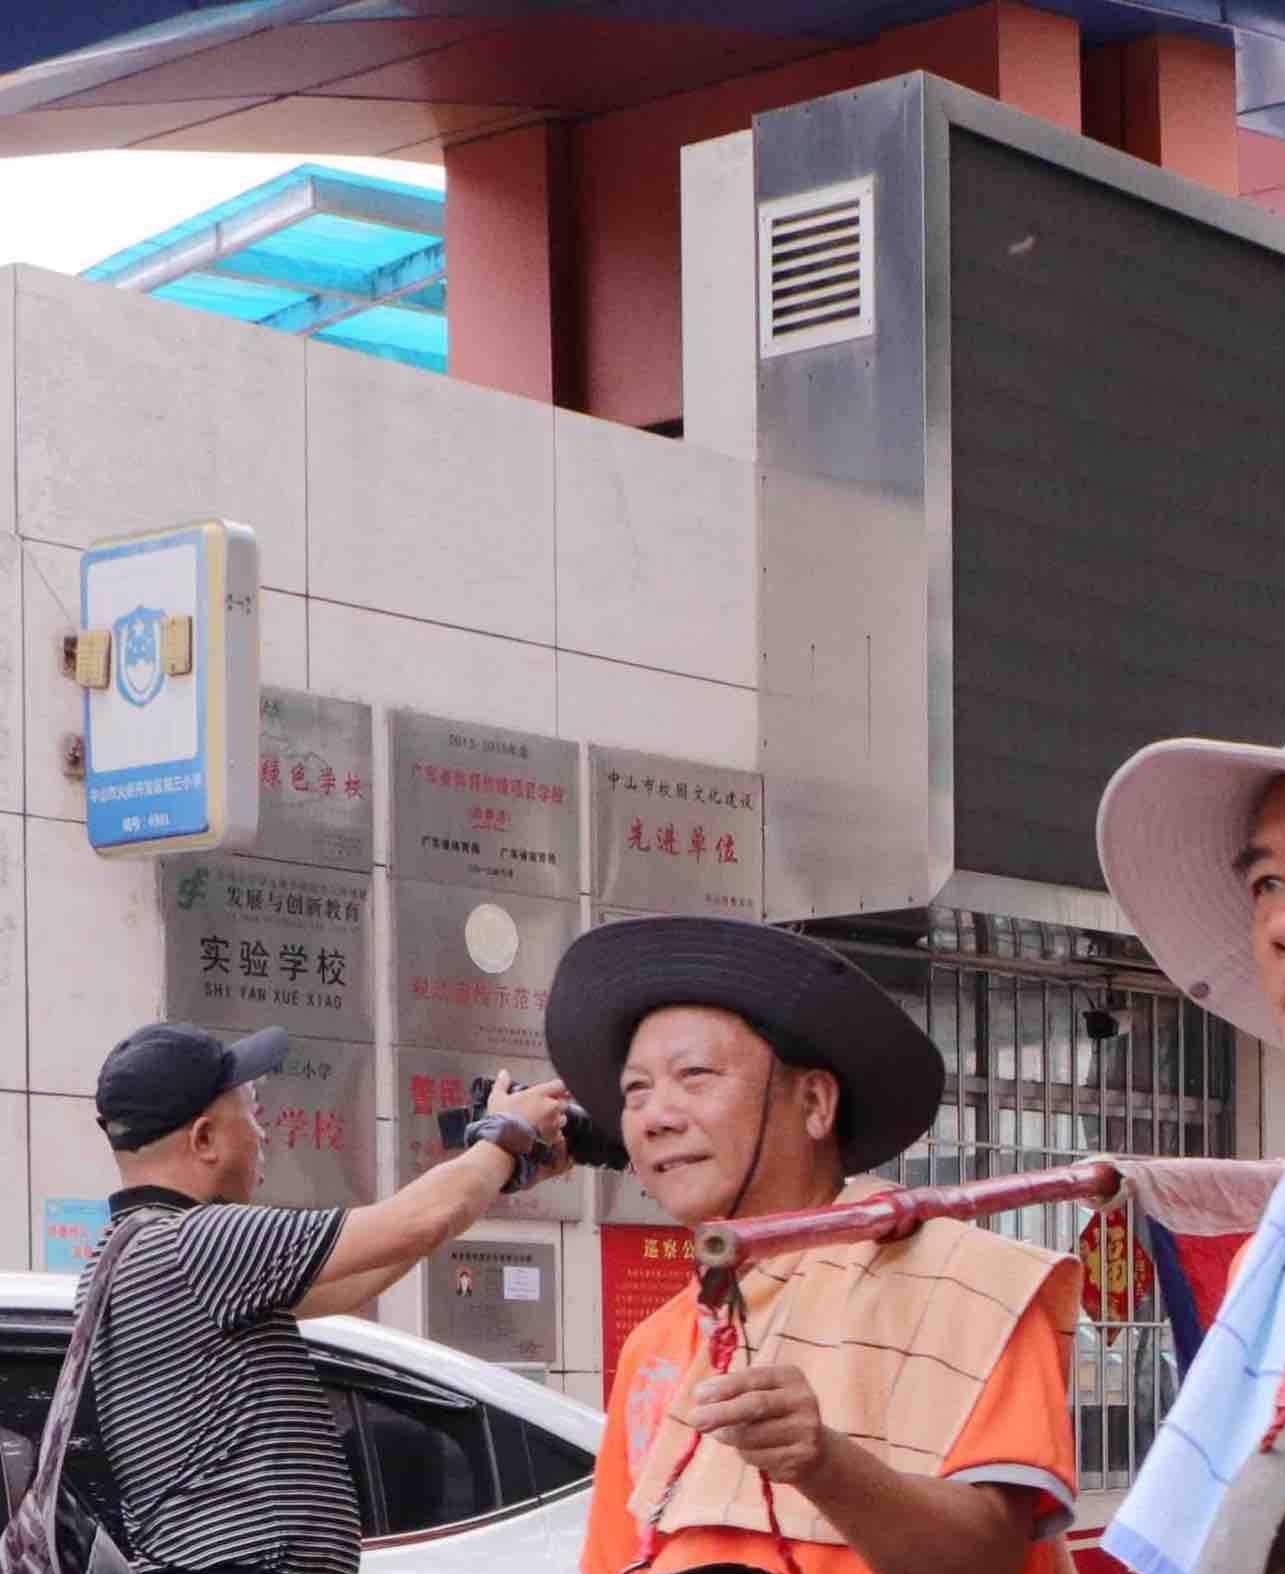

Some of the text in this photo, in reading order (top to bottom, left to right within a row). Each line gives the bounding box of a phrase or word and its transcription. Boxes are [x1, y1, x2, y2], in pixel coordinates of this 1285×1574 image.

[626, 816, 738, 865] 先进单位
[226, 886, 361, 922] 发展与创新教育
[200, 935, 347, 986] 实验学校
